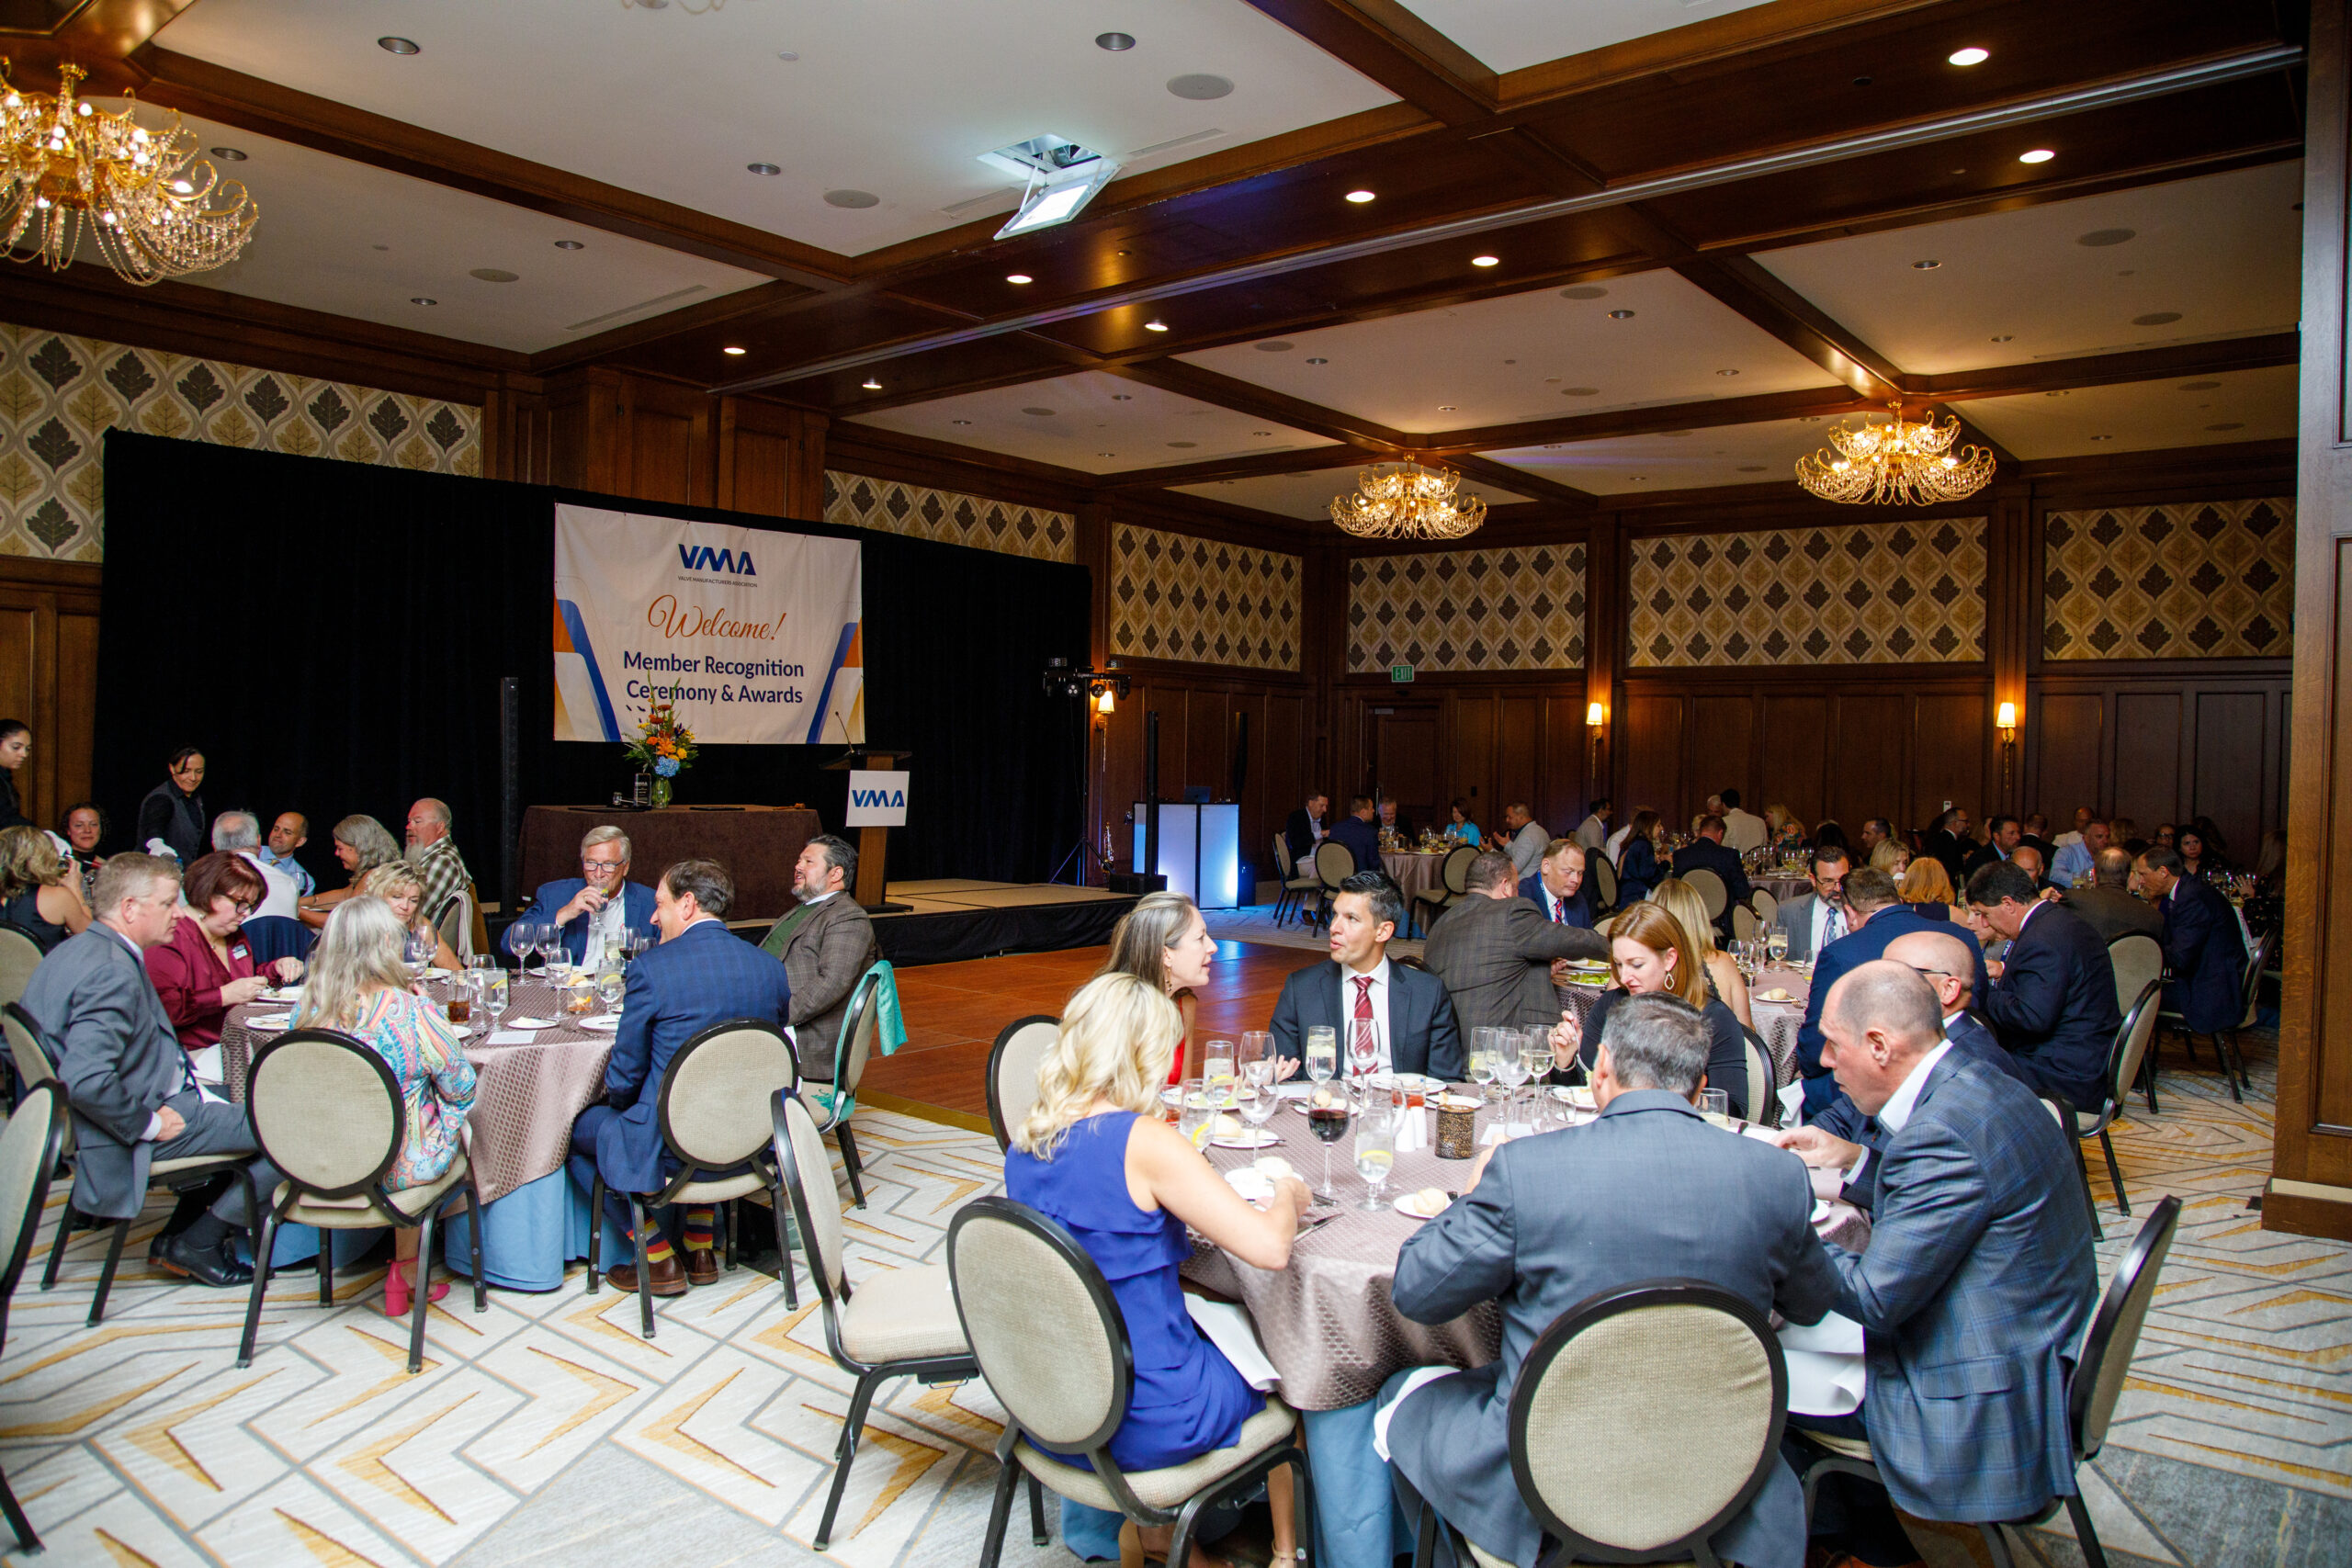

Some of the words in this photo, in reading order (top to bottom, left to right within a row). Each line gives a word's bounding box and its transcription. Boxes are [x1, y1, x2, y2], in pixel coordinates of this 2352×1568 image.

[678, 543, 757, 576] VMA
[693, 577, 732, 586] MANUFACTURERS
[648, 594, 787, 640] Welcome!
[624, 650, 701, 672] Member
[705, 655, 805, 680] Recognition
[1396, 668, 1411, 680] EXIT
[627, 680, 717, 705] Ceremony
[721, 683, 734, 702] &
[738, 684, 803, 704] Awards
[852, 789, 905, 807] VMA
